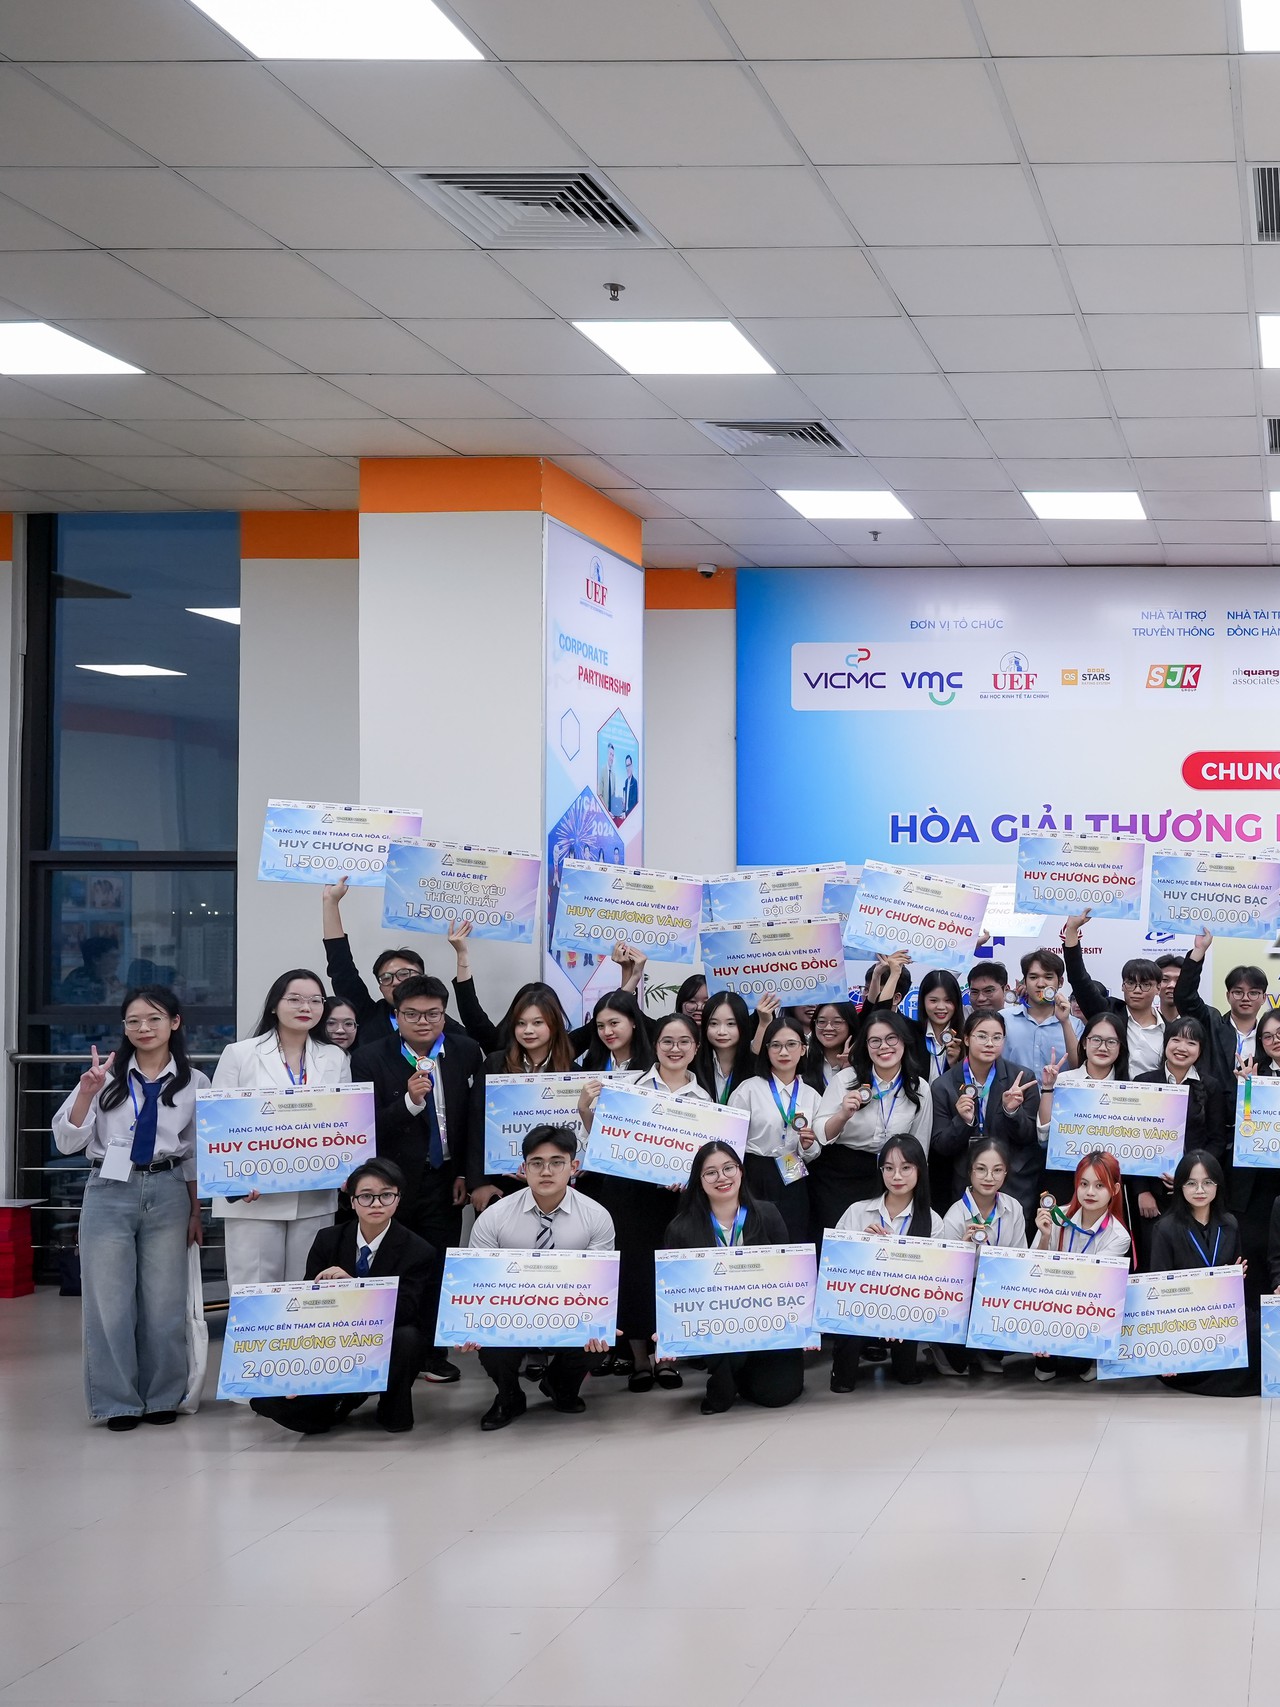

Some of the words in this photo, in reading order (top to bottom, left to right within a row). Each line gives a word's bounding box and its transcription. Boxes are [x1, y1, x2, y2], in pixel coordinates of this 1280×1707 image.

[586, 578, 608, 606] UEF
[1141, 609, 1165, 620] NHÀ
[1167, 609, 1182, 620] TÀI
[1185, 610, 1206, 622] TRỢ
[1227, 609, 1251, 620] NHÀ
[1253, 609, 1268, 620] TÀI
[910, 619, 936, 630] ĐƠN
[939, 620, 950, 631] VỊ
[953, 617, 968, 629] TỔ
[971, 618, 1004, 629] CHỨC
[1132, 625, 1175, 637] TRUYỀN
[1177, 625, 1215, 637] THÔNG
[1227, 624, 1259, 637] ĐỒNG
[558, 633, 609, 667] CORPORATE
[578, 665, 632, 697] PARTNERSHIP
[803, 672, 886, 689] VICMC
[1082, 673, 1111, 681] STARS
[1148, 666, 1199, 687] SJK
[1232, 667, 1280, 678] nhquang
[1232, 676, 1280, 685] associates
[900, 671, 963, 693] vmc
[992, 673, 1038, 691] UEF
[592, 820, 614, 838] 2024
[890, 806, 980, 843] HÒA
[1084, 808, 1262, 843] THƯƠNG
[440, 870, 455, 878] GIẢI
[456, 870, 469, 881] ĐẶC
[470, 871, 488, 882] BIỆT
[1024, 870, 1048, 881] HUY
[1050, 871, 1100, 884] CHƯƠNG
[1102, 872, 1136, 886] ĐỒNG
[418, 877, 442, 891] ĐỘI
[444, 879, 479, 894] ĐƯỢC
[480, 882, 506, 897] YÊU
[424, 890, 462, 905] THÍCH
[463, 894, 499, 908] NHẤT
[228, 1126, 252, 1135] HẠNG
[254, 1124, 275, 1134] MỤC
[276, 1123, 293, 1132] HÒA
[294, 1122, 310, 1130] GIẢI
[312, 1120, 332, 1130] VIÊN
[334, 1120, 349, 1130] ĐẠT
[208, 1142, 244, 1154] HUY
[247, 1136, 319, 1152] CHƯƠNG
[322, 1130, 368, 1147] ĐỒNG
[451, 1294, 485, 1306] HUY
[489, 1293, 560, 1306] CHƯƠNG
[563, 1291, 609, 1307] ĐỒNG
[233, 1338, 266, 1354] HUY
[268, 1334, 337, 1352] CHƯƠNG
[340, 1330, 384, 1348] VÀNG
